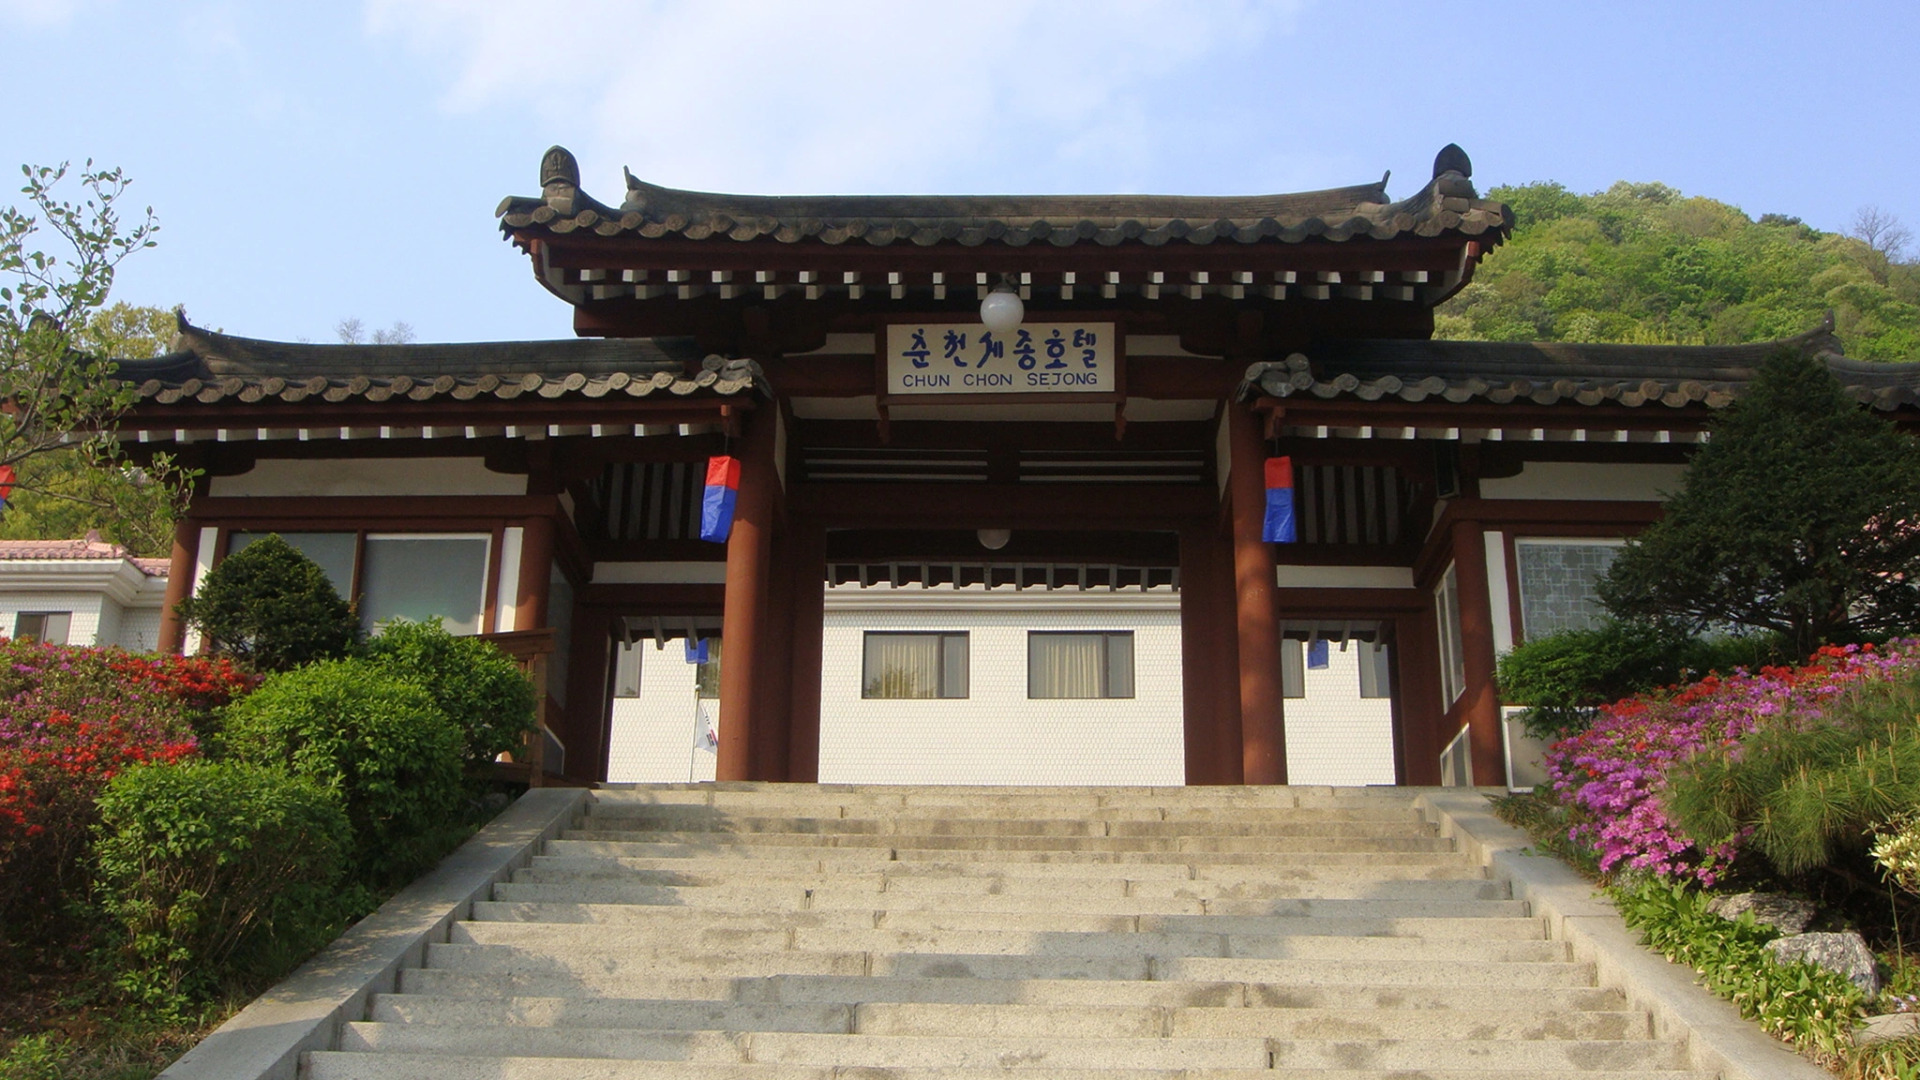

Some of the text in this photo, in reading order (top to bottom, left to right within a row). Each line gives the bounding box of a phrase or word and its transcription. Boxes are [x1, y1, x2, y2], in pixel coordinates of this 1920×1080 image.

[902, 328, 1097, 370] 춘천세종호텔
[903, 372, 1097, 387] CHUN CHON SEJONG
